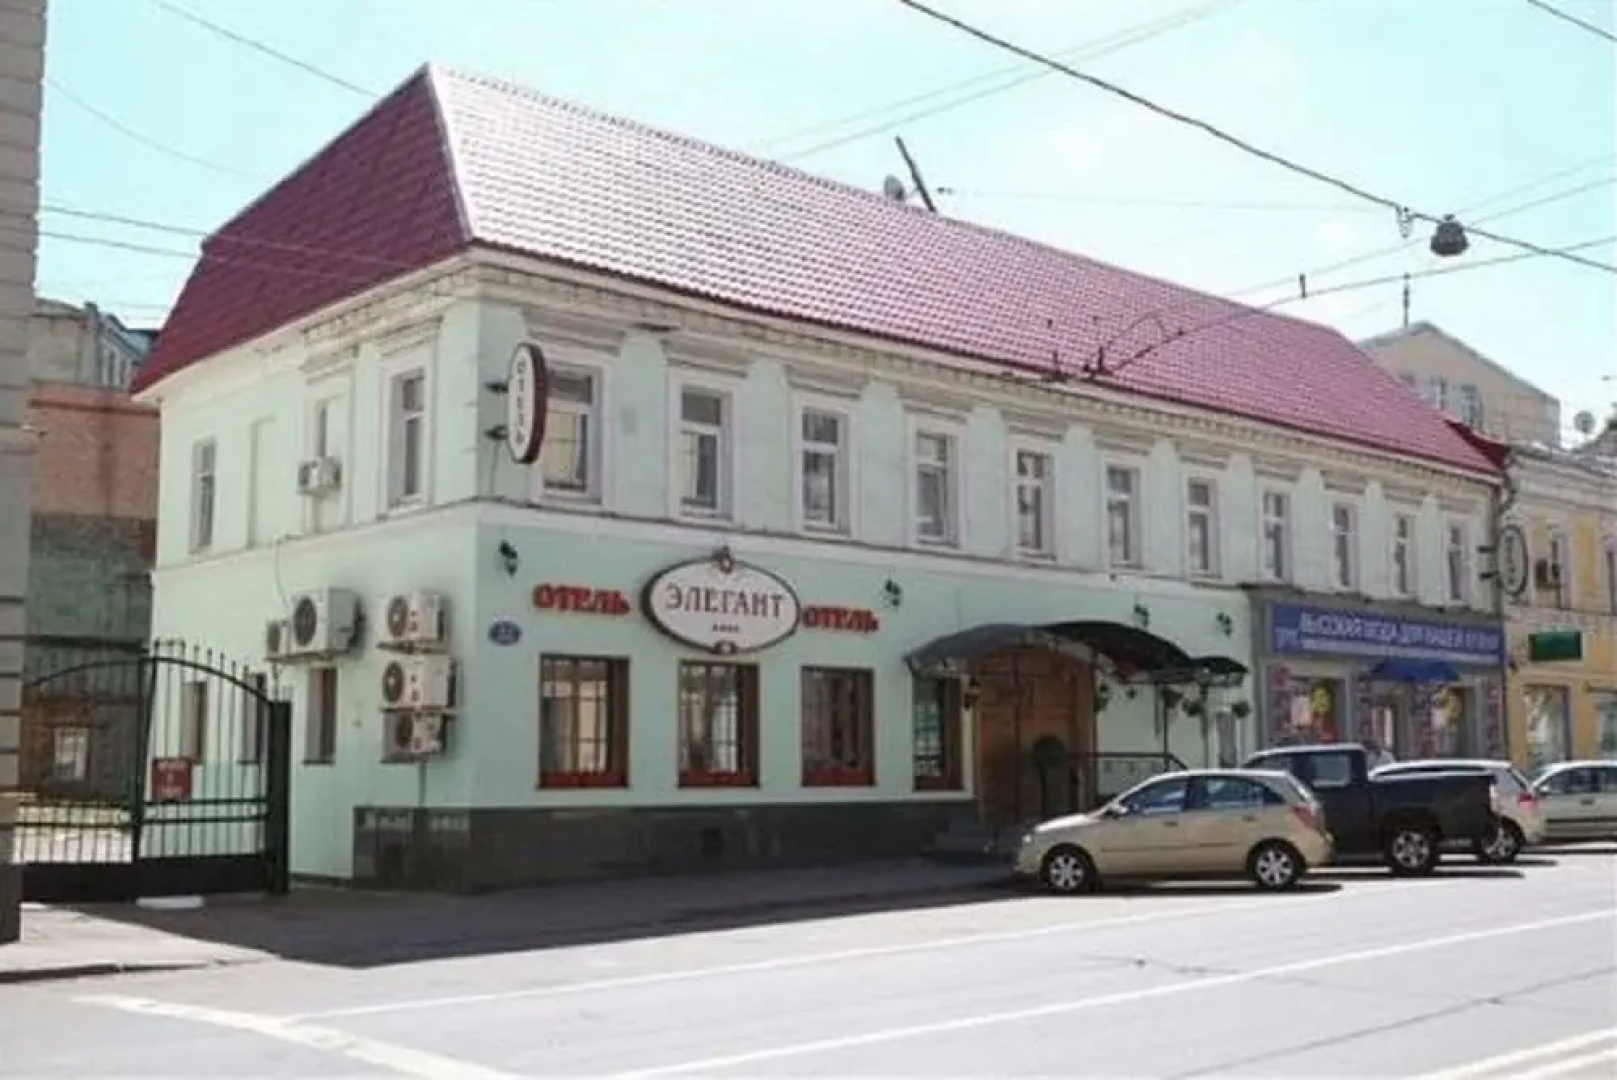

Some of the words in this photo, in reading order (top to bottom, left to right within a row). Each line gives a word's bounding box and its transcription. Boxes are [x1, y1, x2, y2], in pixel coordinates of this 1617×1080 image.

[533, 584, 630, 615] ОТЕЛЬ
[665, 582, 785, 619] ЭЛЕГАНТ
[801, 605, 880, 632] ОТЕЛЬ
